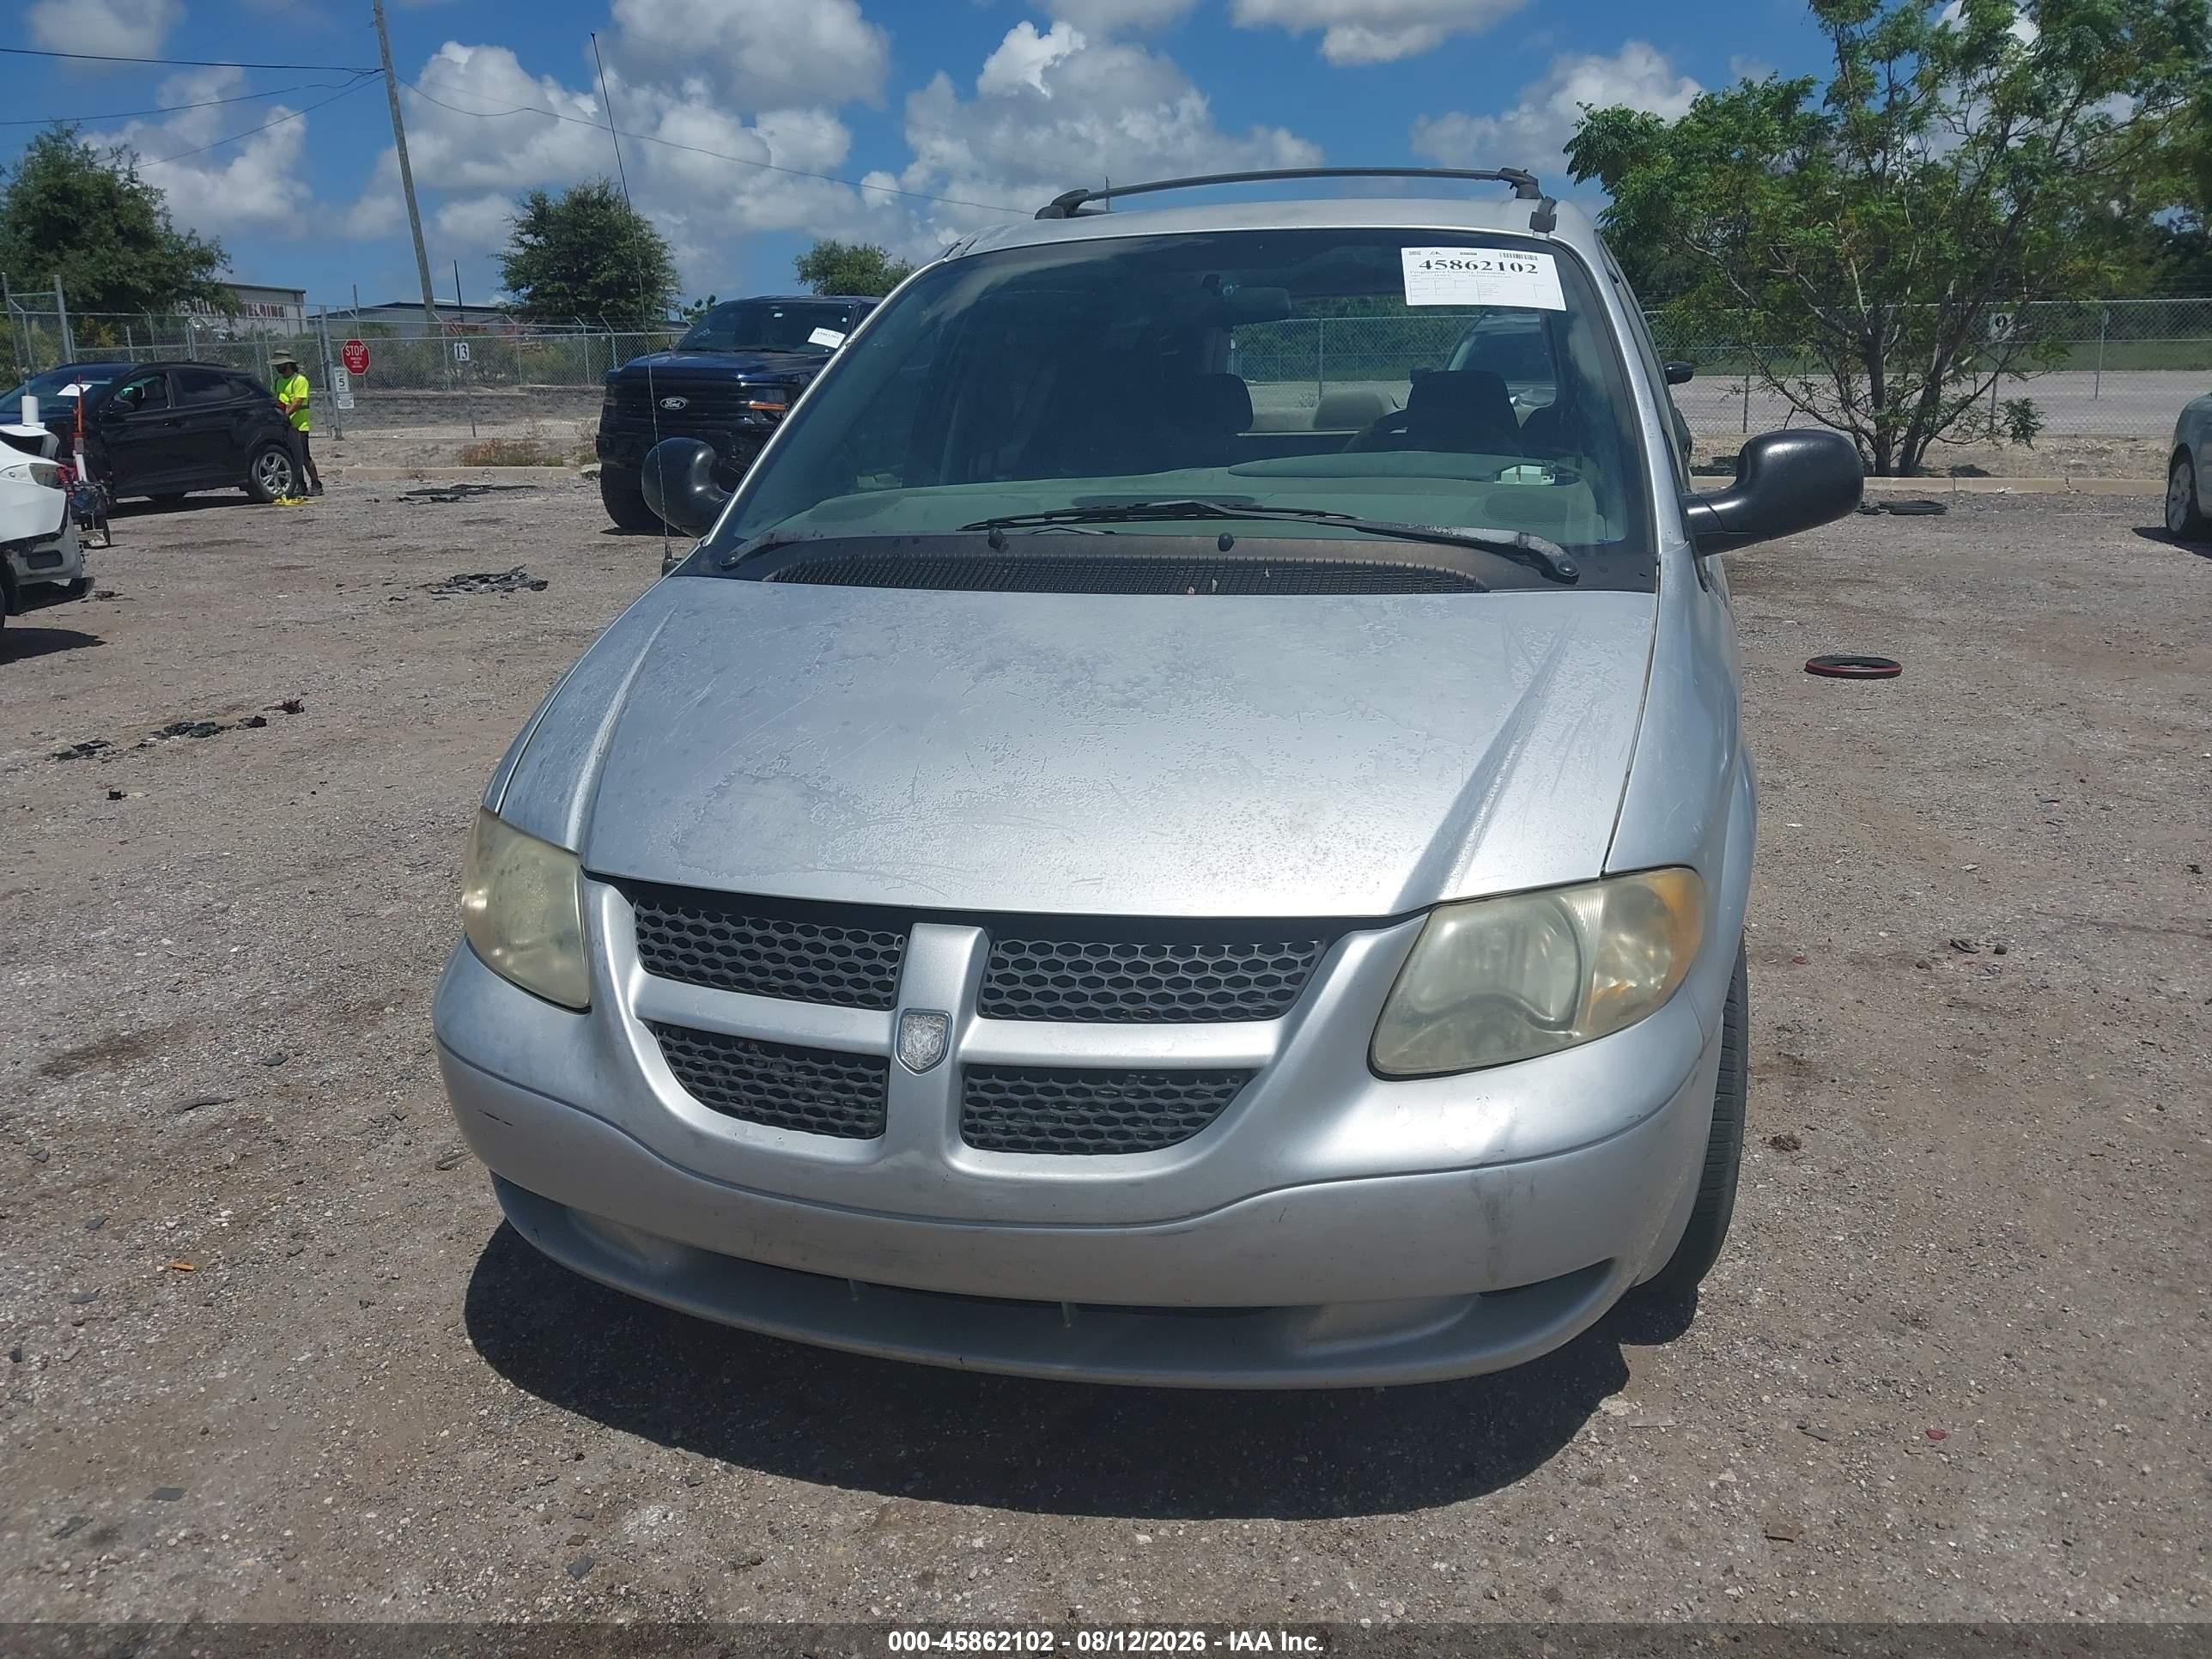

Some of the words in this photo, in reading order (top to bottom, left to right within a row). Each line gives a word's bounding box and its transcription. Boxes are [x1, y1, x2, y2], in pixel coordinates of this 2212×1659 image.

[1419, 259, 1538, 274] 45862102
[345, 345, 365, 356] STOP
[457, 344, 467, 359] 13
[338, 378, 345, 387] 5
